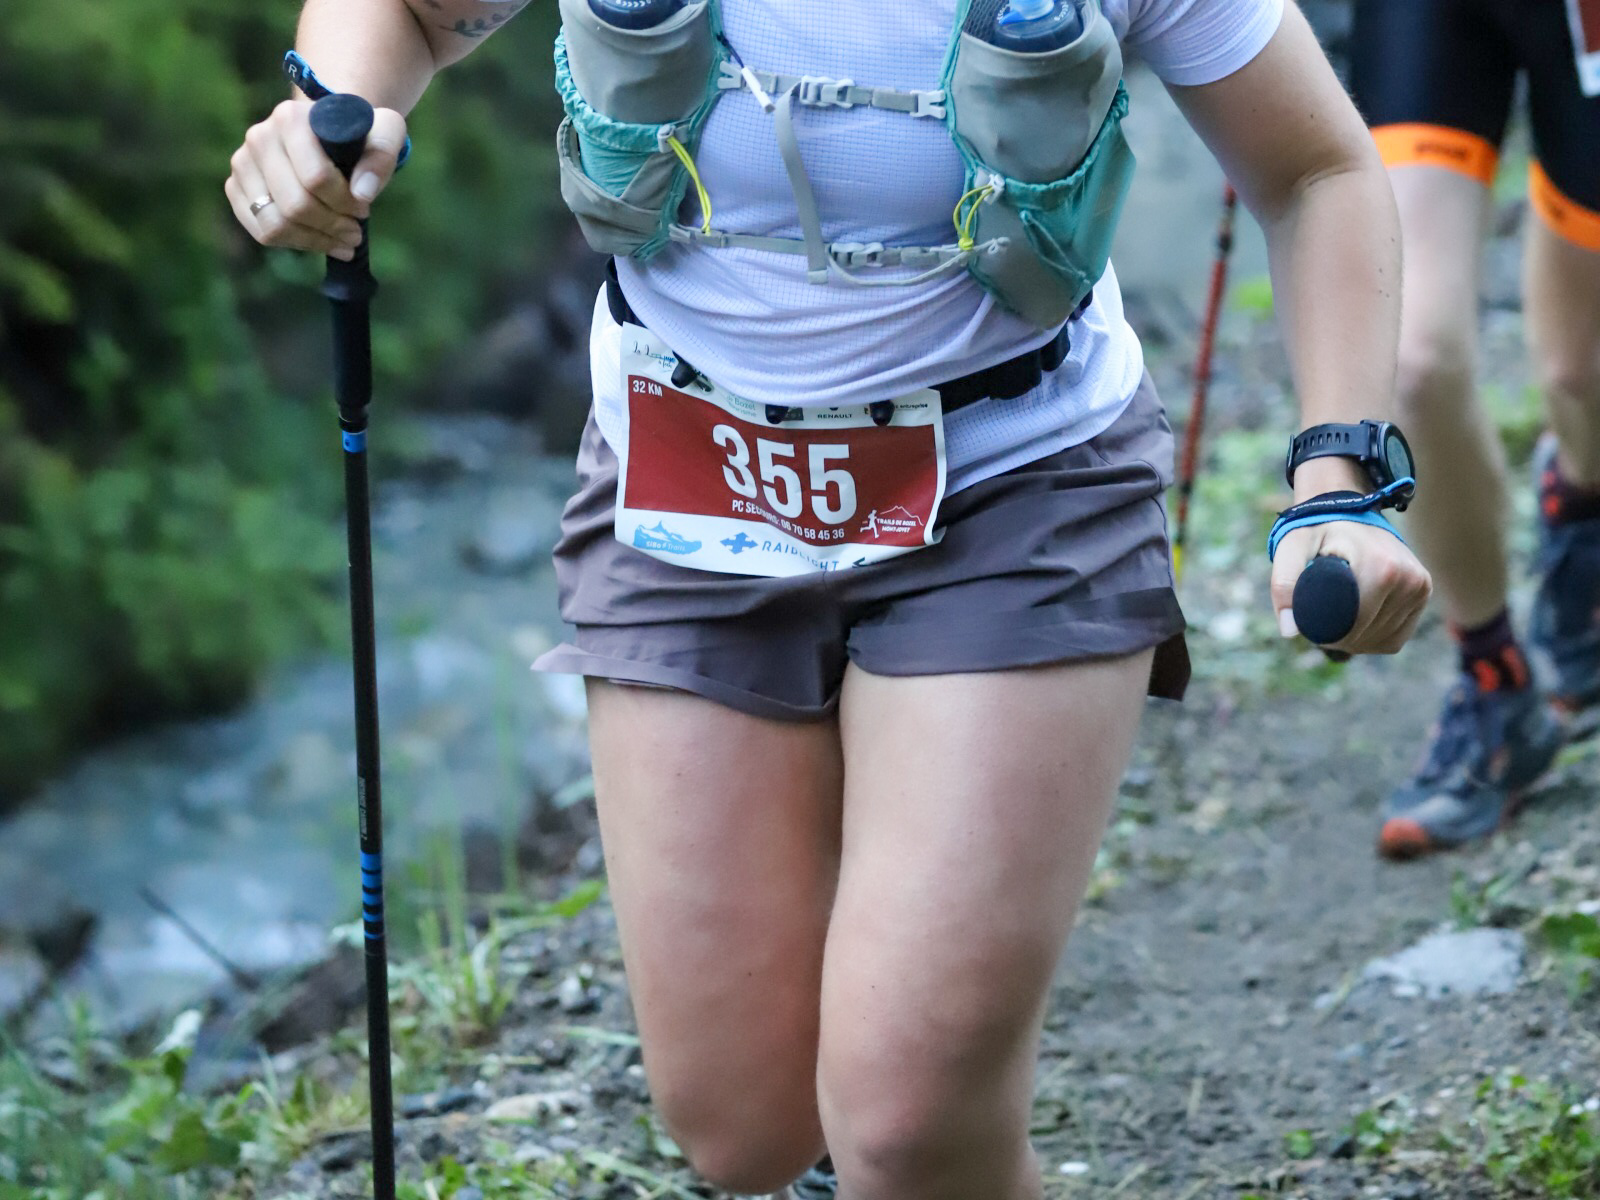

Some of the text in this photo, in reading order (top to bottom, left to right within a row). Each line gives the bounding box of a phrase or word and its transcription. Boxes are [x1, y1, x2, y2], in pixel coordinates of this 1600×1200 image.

[288, 63, 298, 79] R
[632, 380, 663, 397] 32 KM
[711, 423, 858, 525] 355
[732, 499, 744, 512] PC
[792, 523, 803, 536] 70
[803, 528, 816, 540] 58
[817, 529, 830, 541] 45
[832, 528, 844, 539] 36
